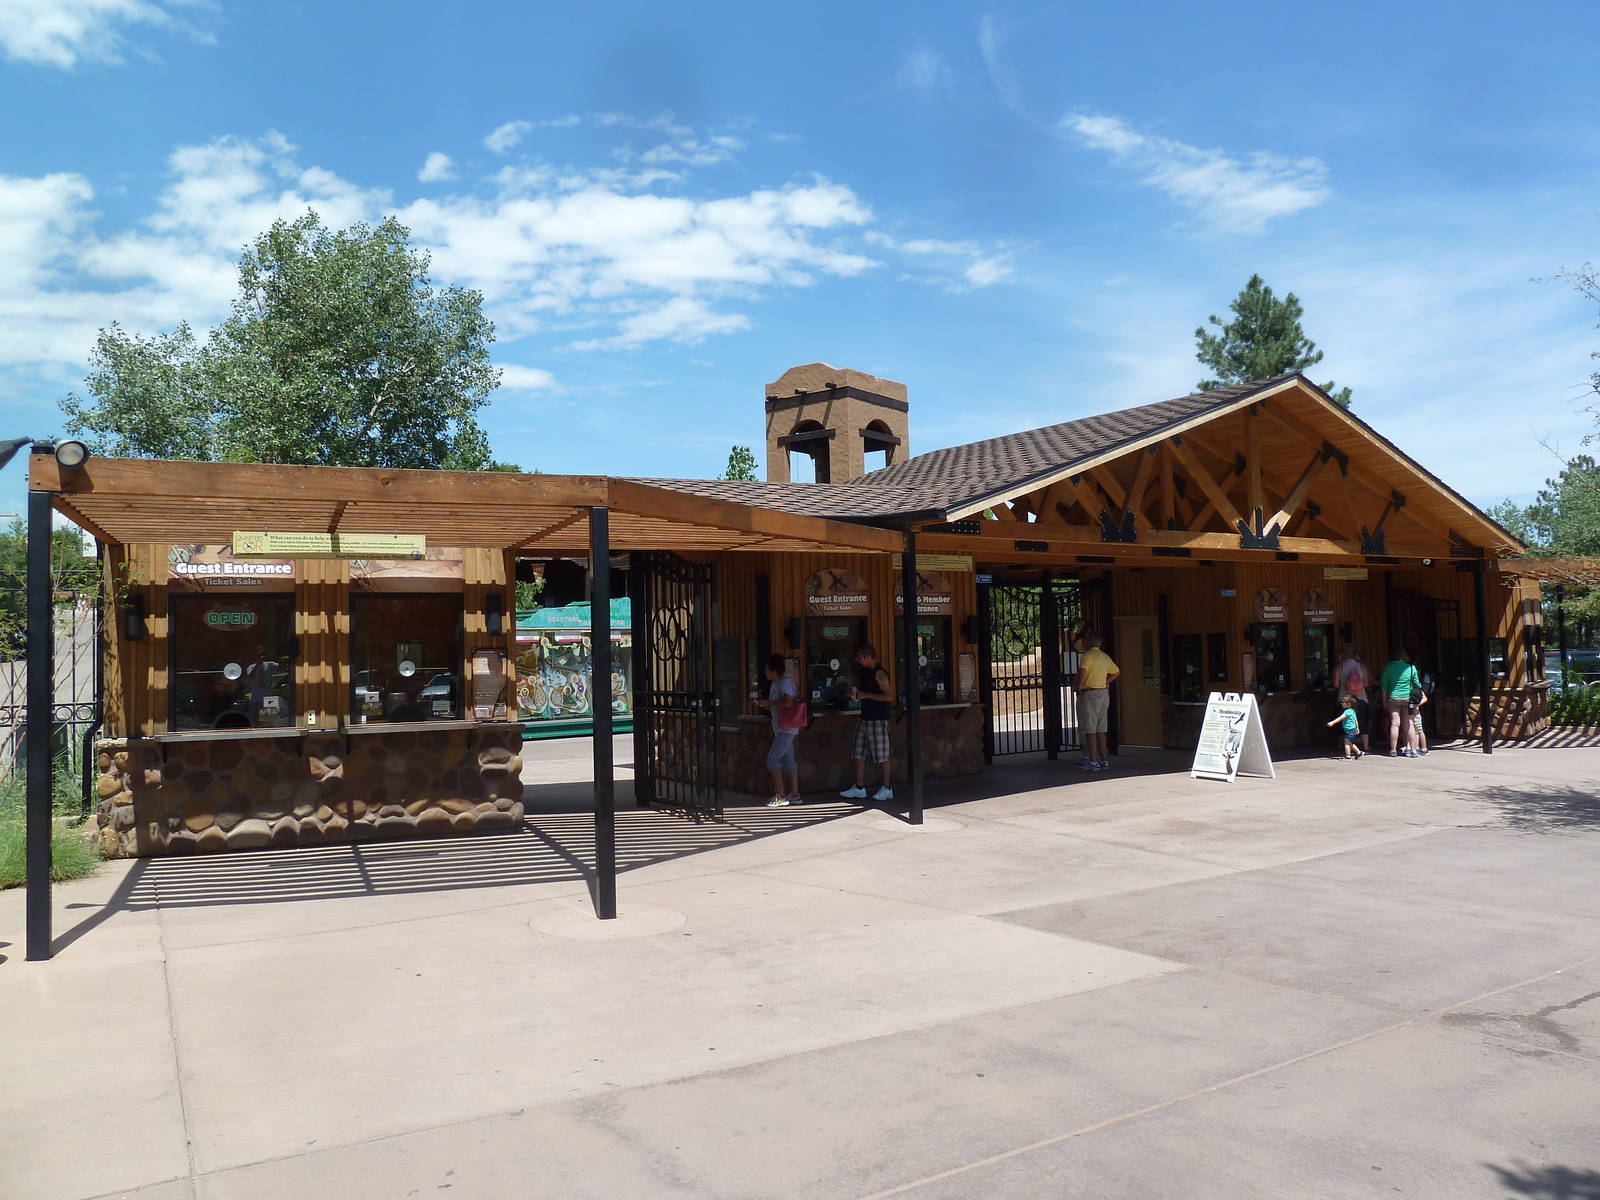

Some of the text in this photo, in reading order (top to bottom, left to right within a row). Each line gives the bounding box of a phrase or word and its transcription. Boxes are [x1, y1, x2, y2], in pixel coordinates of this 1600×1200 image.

[176, 562, 292, 574] Guest Entrance
[205, 578, 263, 586] Ticket Sales
[809, 594, 867, 604] Guest Entrance
[917, 605, 939, 613] trance
[208, 613, 255, 625] OPEN
